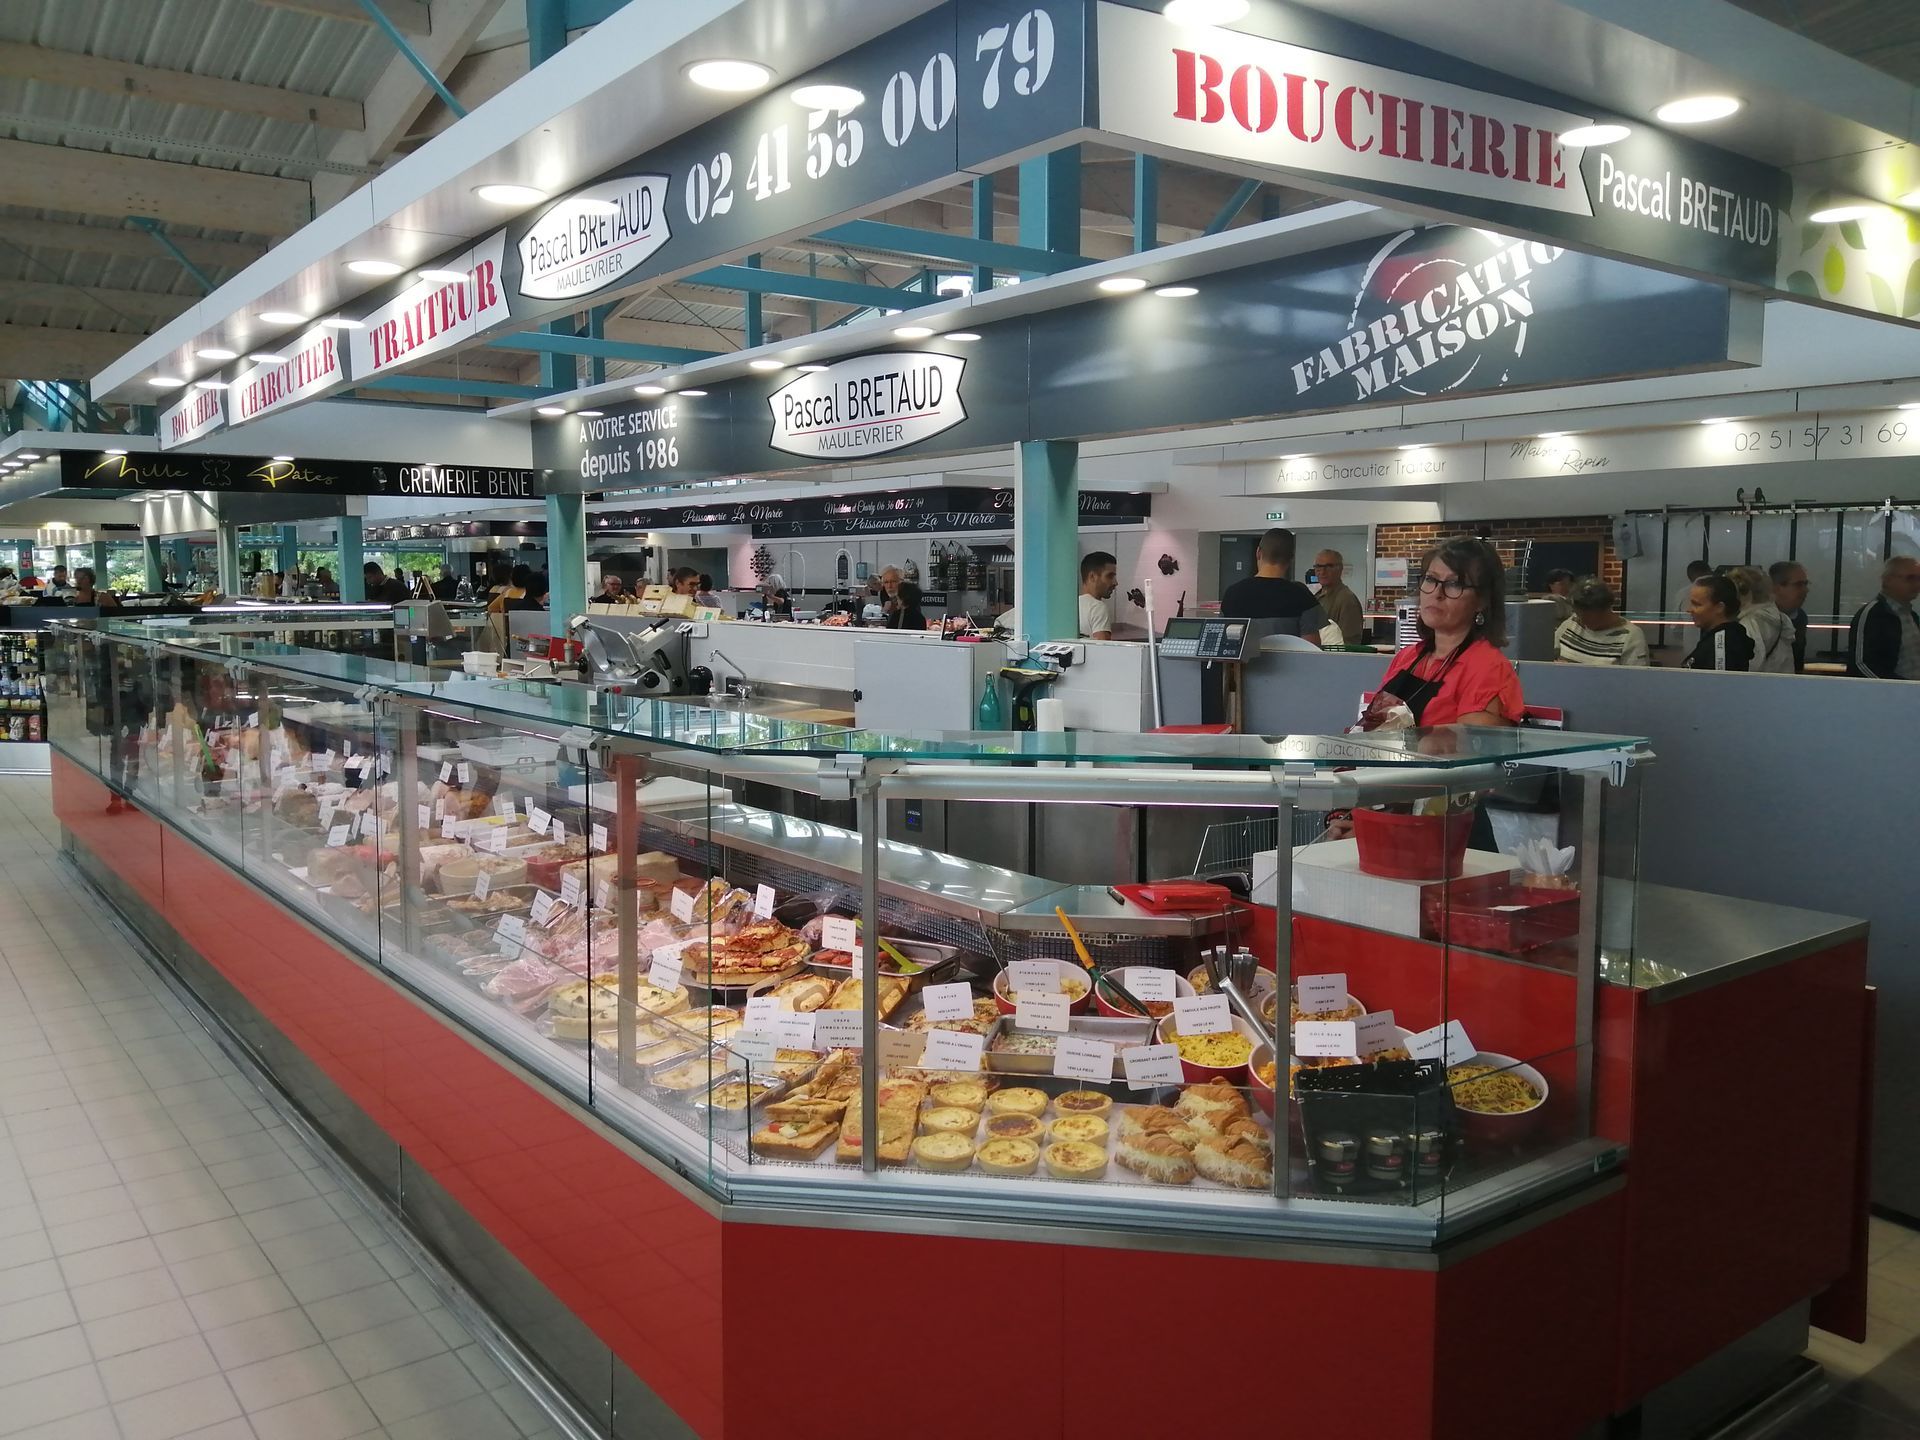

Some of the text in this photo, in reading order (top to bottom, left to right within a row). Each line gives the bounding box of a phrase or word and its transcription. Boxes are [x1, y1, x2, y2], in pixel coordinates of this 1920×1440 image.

[686, 8, 1055, 224] 02 41 55 00 79
[1172, 47, 1567, 190] BOUCHERIE
[1598, 152, 1773, 247] Pascal BRETAUD
[530, 185, 653, 274] Pascal BRETAUD
[556, 254, 624, 293] MAULEVRIER
[368, 258, 498, 370] TRAITEUR
[1352, 280, 1534, 401] MAISON
[240, 334, 336, 419] CHARCUTIER
[783, 364, 944, 432] Pascal BRETAUD
[171, 388, 219, 443] BOUCHER
[579, 405, 678, 444] A VOTRE SERVICE
[1734, 422, 1908, 452] 02 51 57 31 69
[580, 436, 679, 483] depuis 1986
[817, 424, 905, 452] MAULEVRIER
[84, 455, 338, 488] Mille Pâtes
[399, 467, 534, 496] CREMERIE BENE
[1322, 463, 1390, 481] Charcutier
[1560, 449, 1610, 473] Rapin
[682, 504, 784, 524] Poissonnerie La Marée
[845, 512, 997, 531] Poissonnerie La Marée
